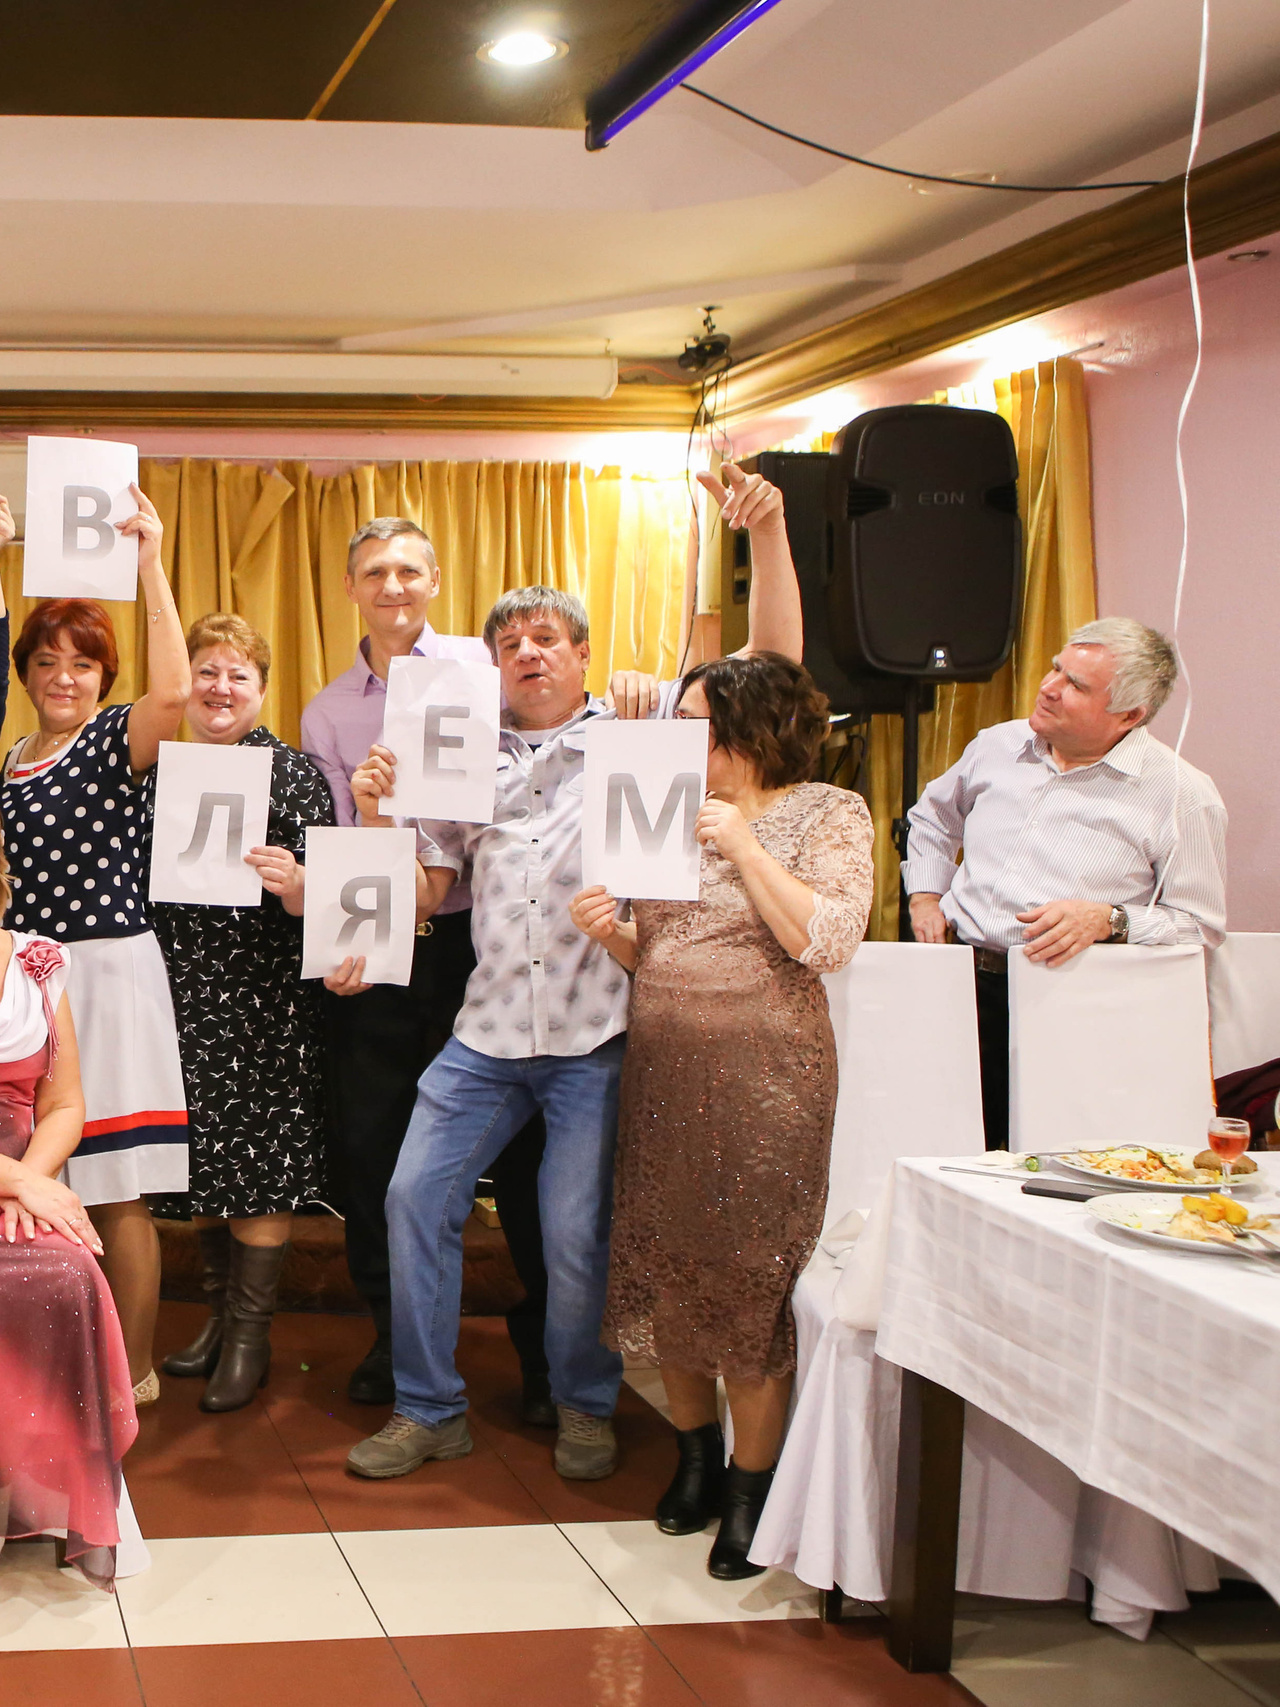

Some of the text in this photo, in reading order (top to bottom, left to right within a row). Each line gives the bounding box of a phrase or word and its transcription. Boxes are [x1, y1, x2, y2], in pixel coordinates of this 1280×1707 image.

[62, 485, 116, 560] В
[422, 705, 471, 781] Е
[177, 791, 246, 869] Л
[604, 772, 701, 856] М
[335, 875, 392, 949] Я
